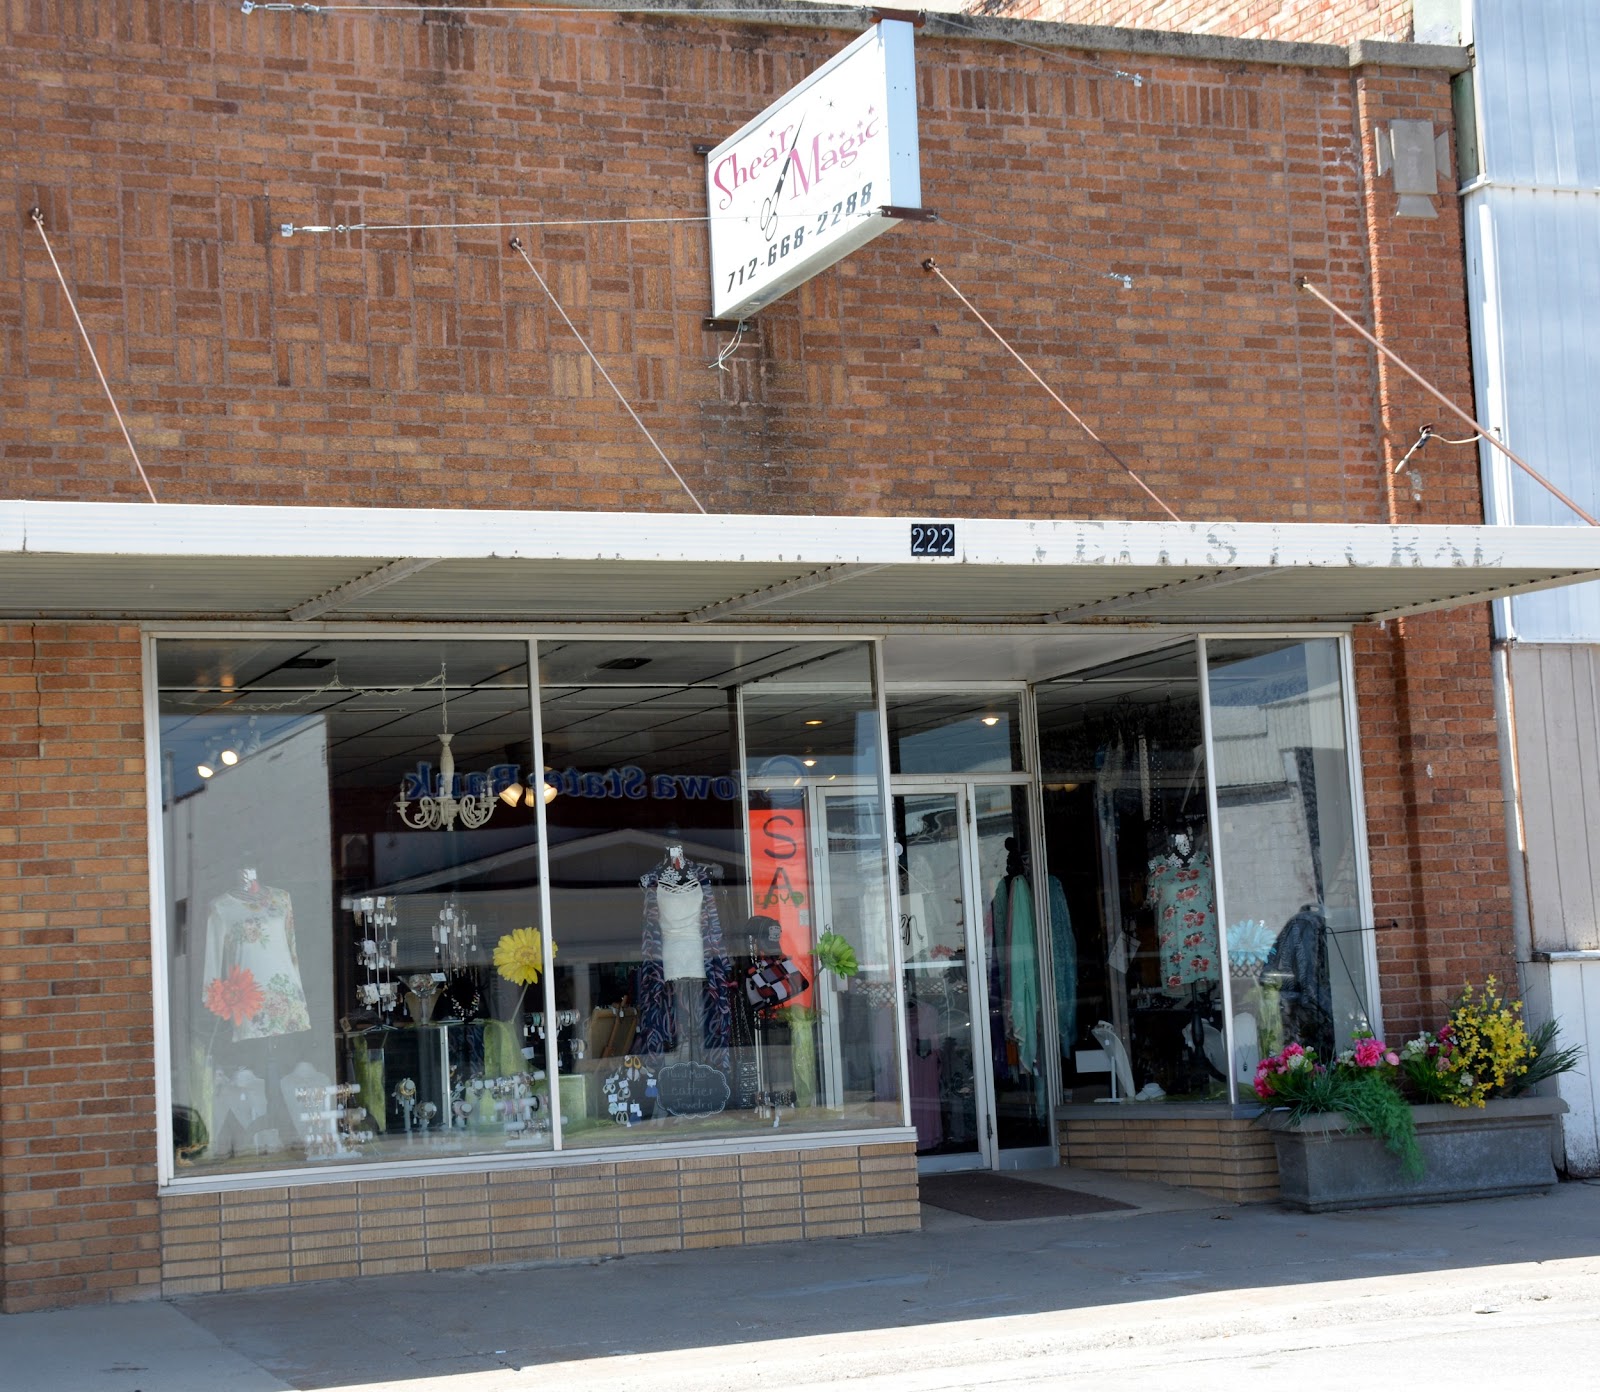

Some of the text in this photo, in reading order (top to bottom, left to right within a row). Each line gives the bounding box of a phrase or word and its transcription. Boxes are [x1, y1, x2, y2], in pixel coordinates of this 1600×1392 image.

[713, 124, 794, 210] Shear
[789, 115, 880, 201] Magic
[726, 181, 874, 294] 712-668-2288
[911, 526, 954, 553] 222
